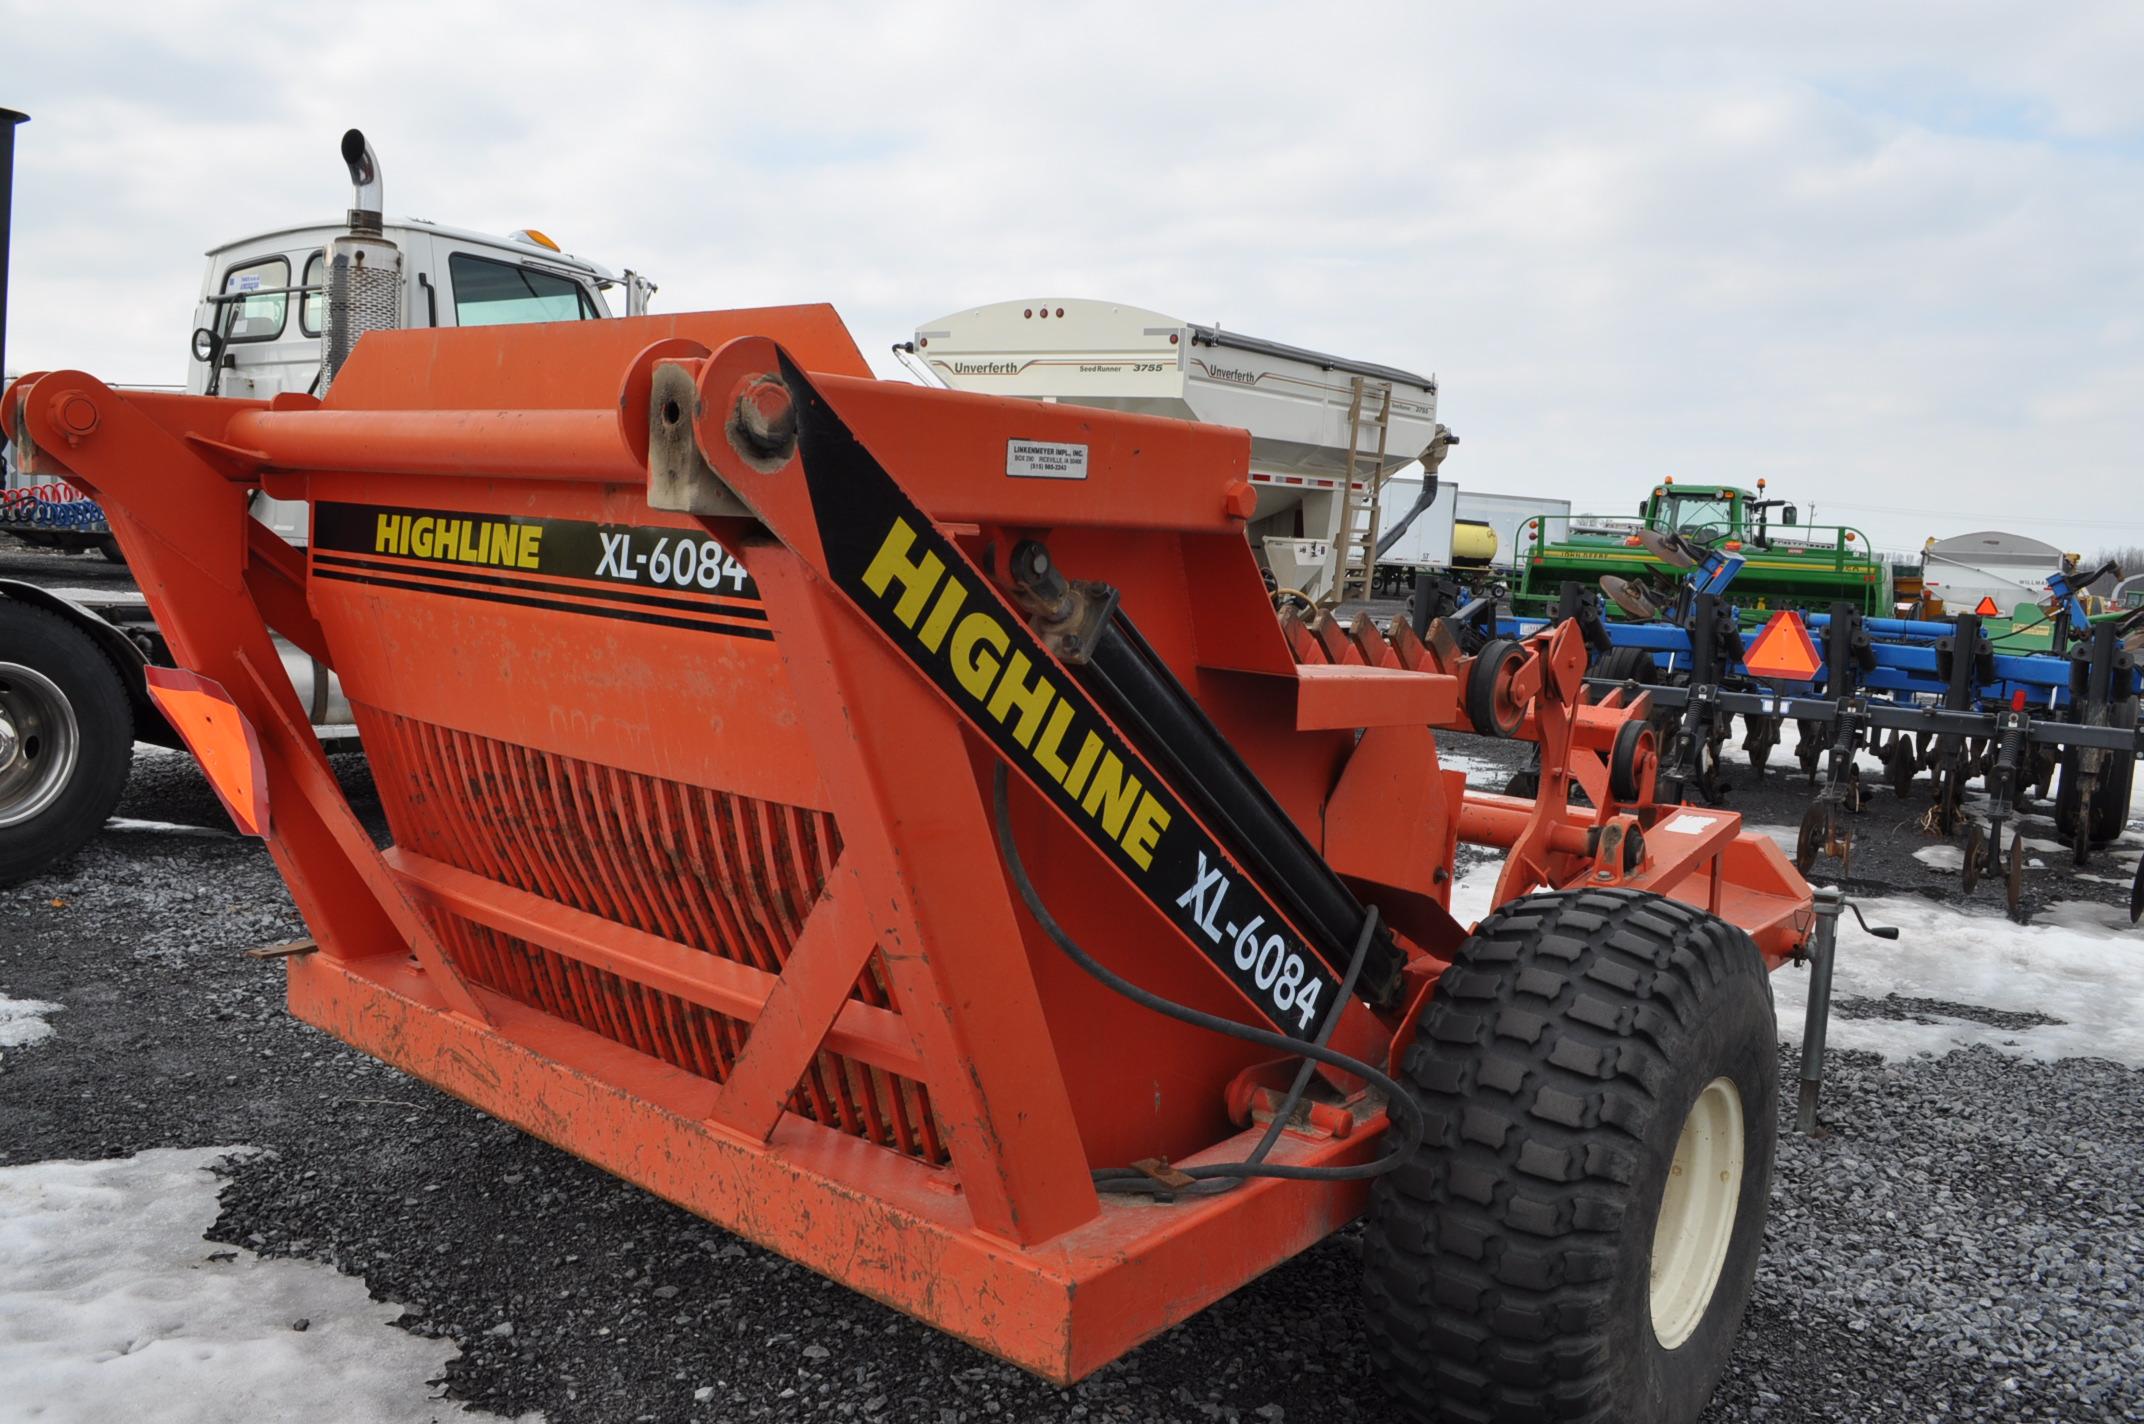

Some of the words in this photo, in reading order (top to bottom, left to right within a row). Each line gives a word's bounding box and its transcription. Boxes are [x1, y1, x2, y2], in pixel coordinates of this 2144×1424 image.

[955, 362, 1018, 374] Unverferth
[1132, 363, 1163, 372] 3755
[1210, 364, 1255, 383] Unverferth
[375, 513, 544, 569] HIGHLINE
[595, 531, 748, 592] XL-6084
[861, 515, 1172, 873] HIGHLINE
[1175, 850, 1324, 1031] XL-6084
